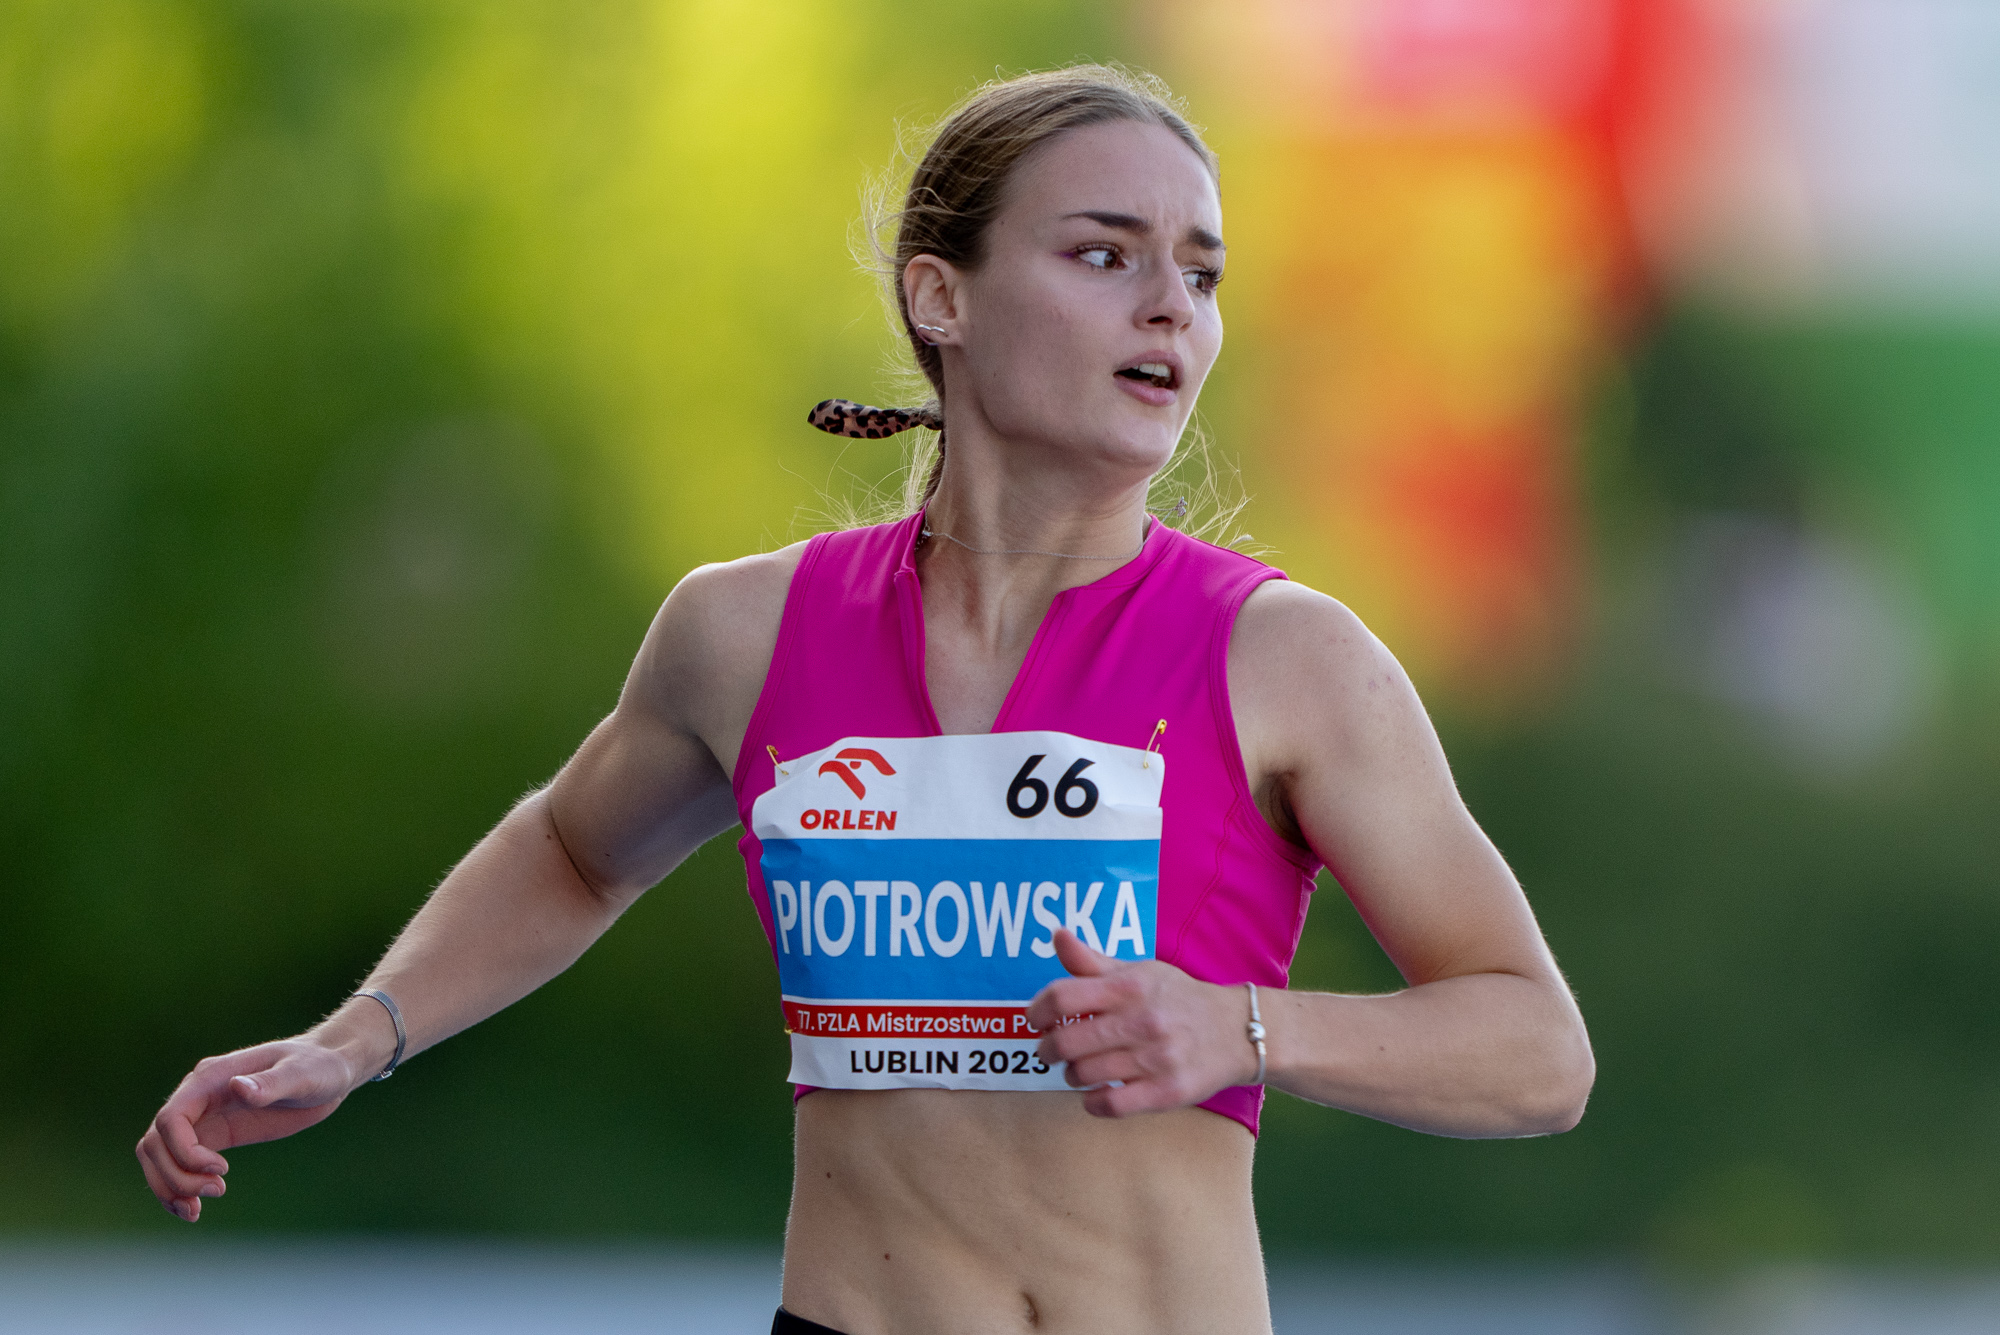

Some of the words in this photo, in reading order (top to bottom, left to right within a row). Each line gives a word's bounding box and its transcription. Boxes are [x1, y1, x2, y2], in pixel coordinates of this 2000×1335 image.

[1006, 753, 1099, 819] 66
[800, 808, 898, 831] ORLEN
[772, 879, 1146, 959] PIOTROWSKA
[797, 1009, 815, 1031] 77.
[817, 1012, 861, 1032] PZLA
[866, 1011, 1006, 1034] Mistrzostwa
[850, 1050, 959, 1074] LUBLIN
[968, 1050, 1051, 1075] 2023
